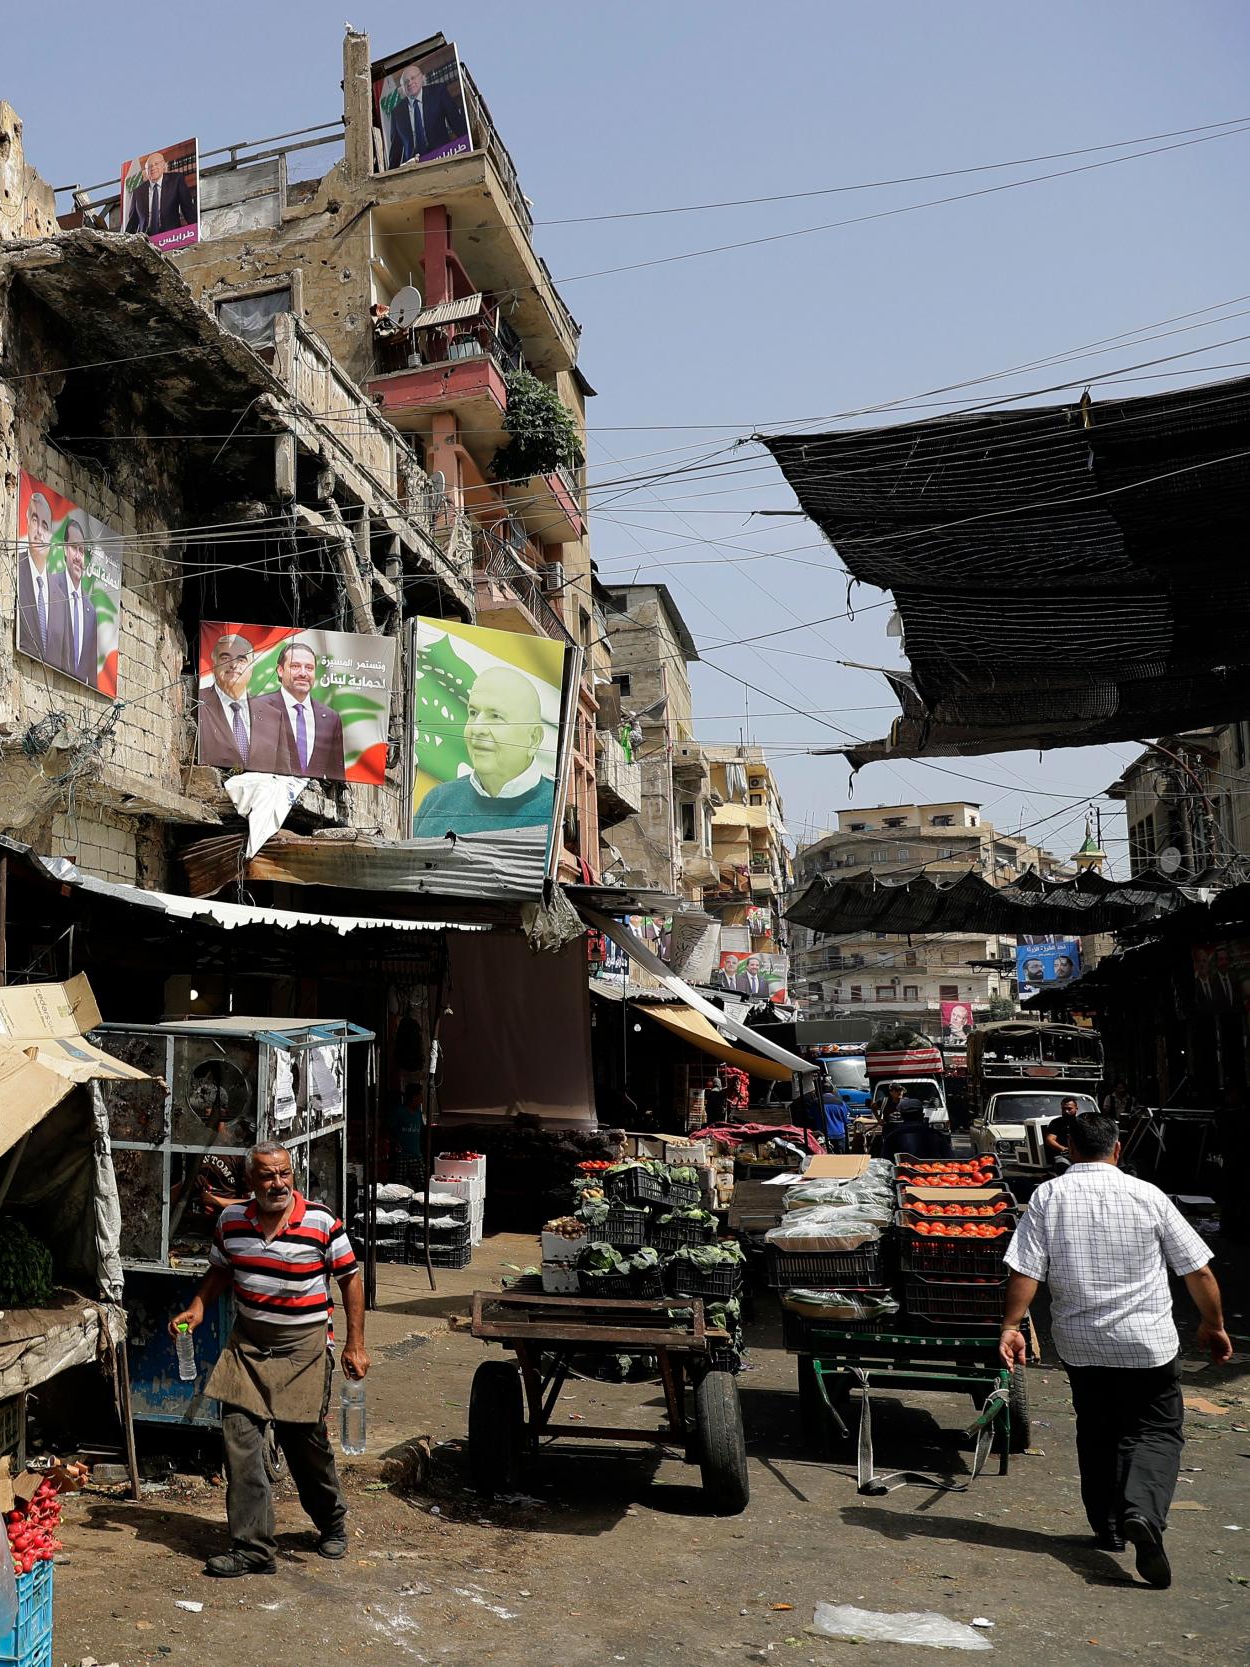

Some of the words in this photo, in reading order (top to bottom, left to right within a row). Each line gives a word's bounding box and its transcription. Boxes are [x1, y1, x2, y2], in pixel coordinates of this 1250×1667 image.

[158, 230, 195, 247] طرابلس
[321, 655, 353, 668] المسيرة
[356, 660, 386, 673] وتستمر
[320, 672, 347, 688] لبنان
[348, 674, 386, 690] لحماية
